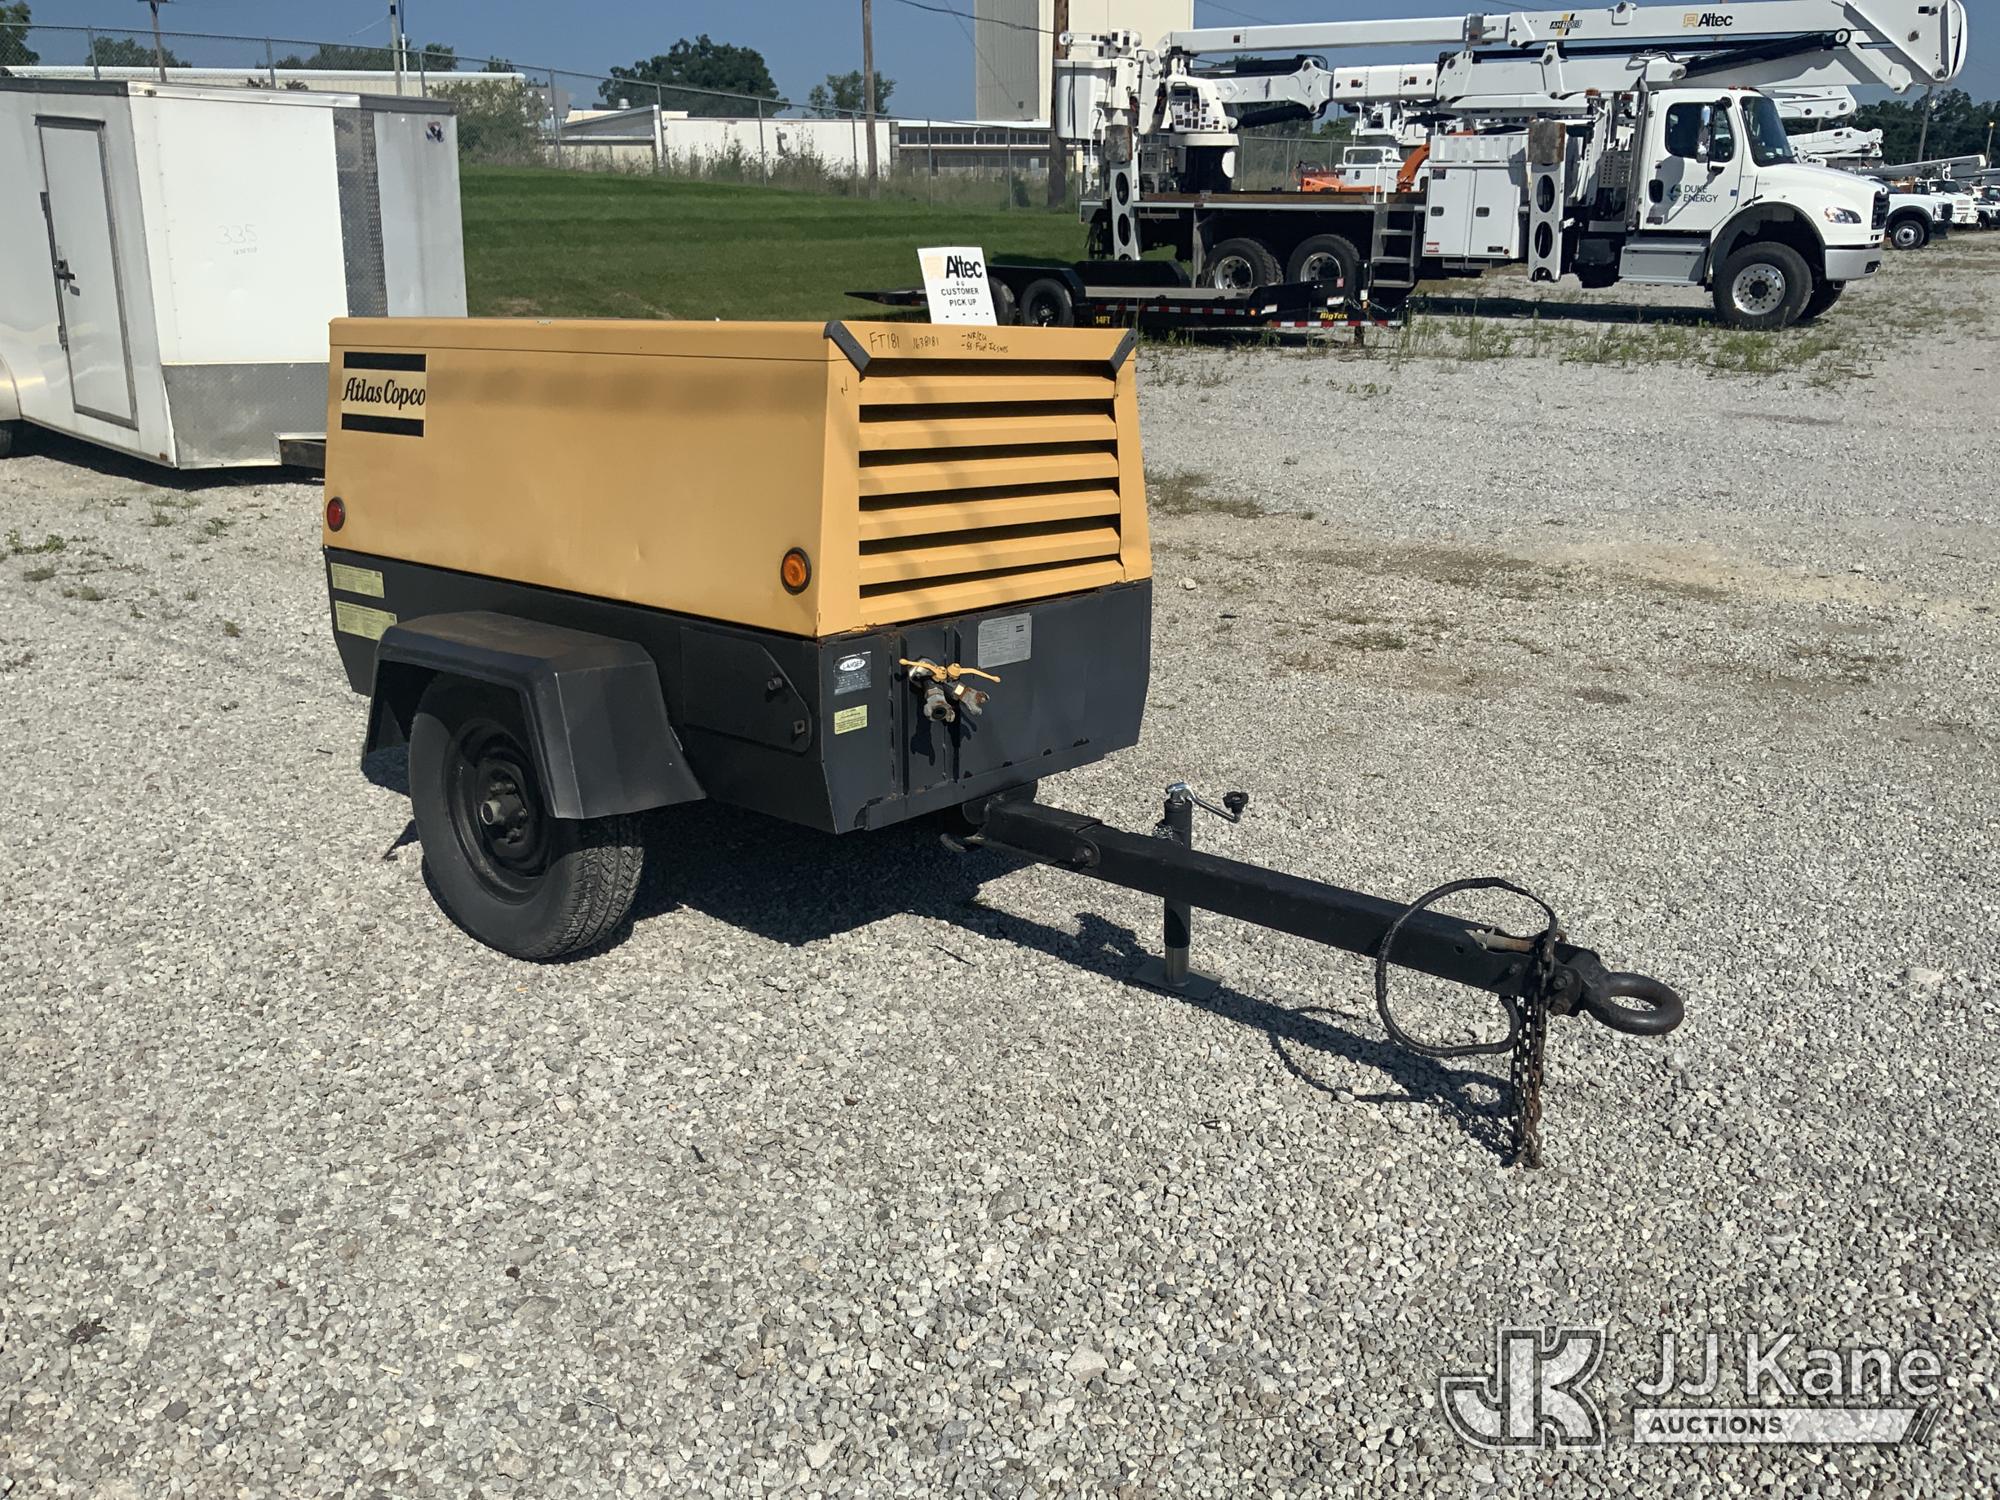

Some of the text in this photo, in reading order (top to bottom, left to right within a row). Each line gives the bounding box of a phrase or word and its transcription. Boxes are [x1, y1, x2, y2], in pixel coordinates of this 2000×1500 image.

[1698, 13, 1733, 27] Altec
[1684, 184, 1708, 194] DUKE
[1683, 194, 1719, 203] ENERGY
[215, 223, 258, 245] 335
[945, 255, 983, 279] Altec
[940, 287, 979, 296] CUSTOMER
[948, 298, 977, 307] PICK UP
[342, 377, 426, 411] Atlas Copco
